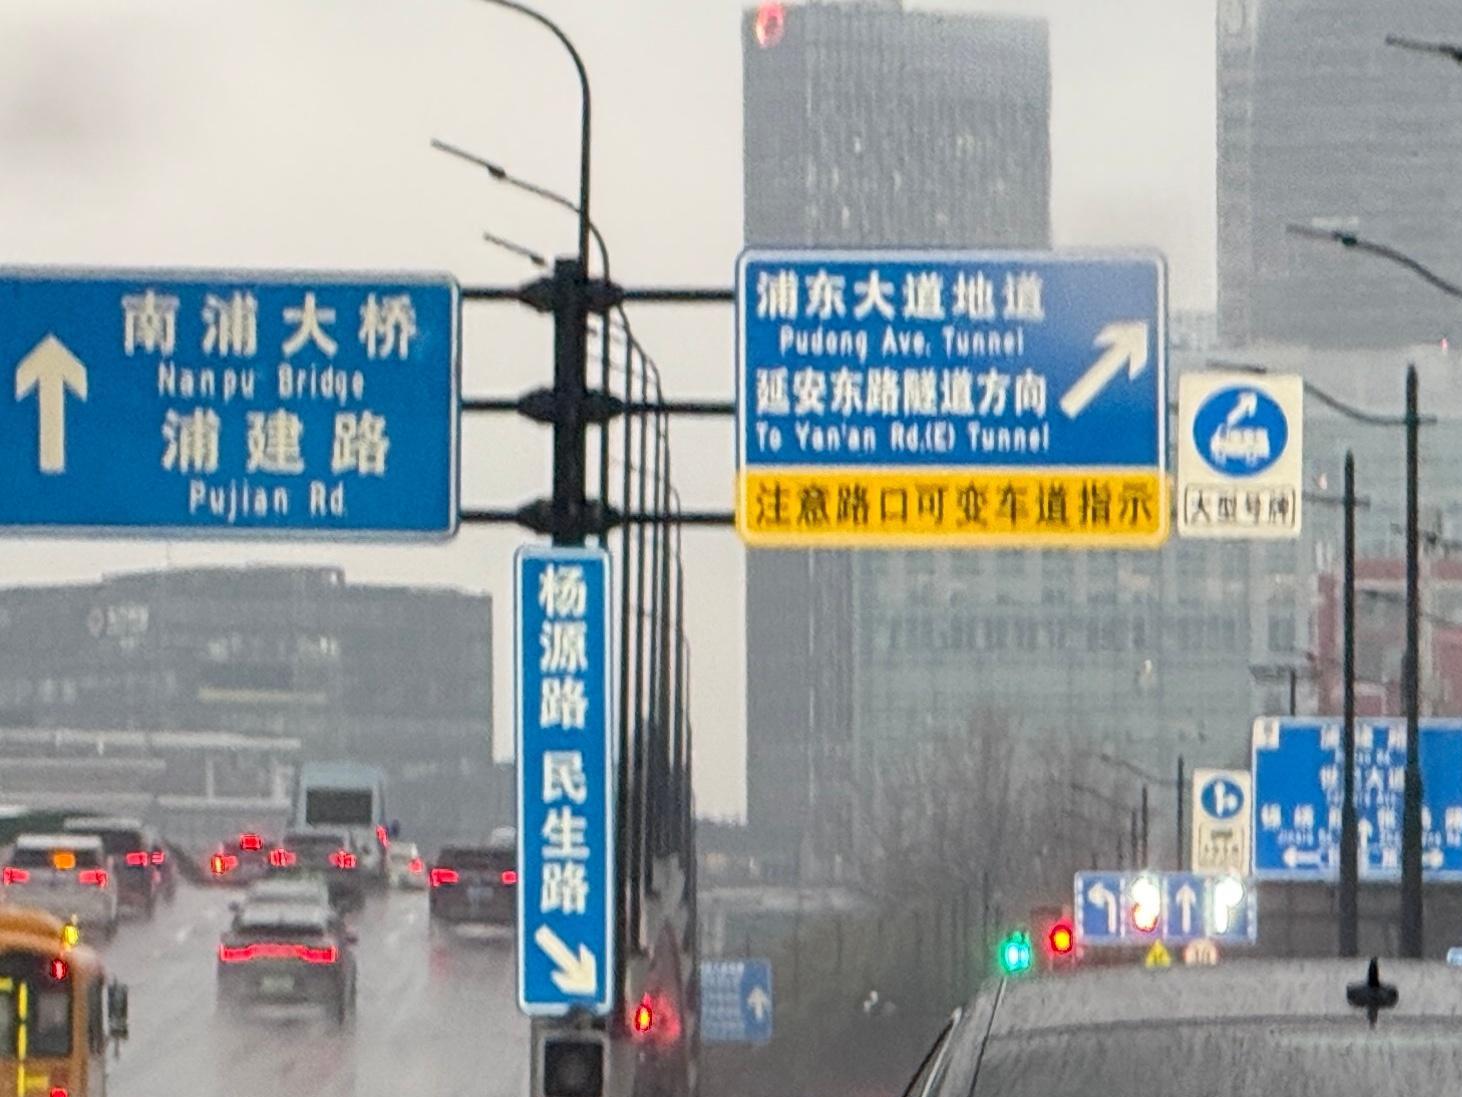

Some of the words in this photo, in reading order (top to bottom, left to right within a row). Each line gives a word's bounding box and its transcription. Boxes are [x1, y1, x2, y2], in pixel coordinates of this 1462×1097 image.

[757, 269, 1045, 322] 浦东大道地道
[121, 290, 417, 358] 南浦大桥
[779, 325, 868, 364] Pudong
[942, 326, 1024, 357] Tunnel
[157, 361, 256, 402] Nanpu
[277, 363, 365, 405] Bridge
[756, 366, 1047, 417] 延安东路隧道方向
[161, 407, 390, 476] 浦建路
[757, 420, 782, 452] To
[795, 419, 876, 452] Yan'an
[967, 420, 1049, 452] Tunnel
[189, 479, 289, 522] Pujian
[310, 480, 345, 517] Rd
[756, 480, 1153, 529] 注意路口可变车道指示
[539, 564, 588, 730] 杨源路
[540, 750, 590, 915] 民生路
